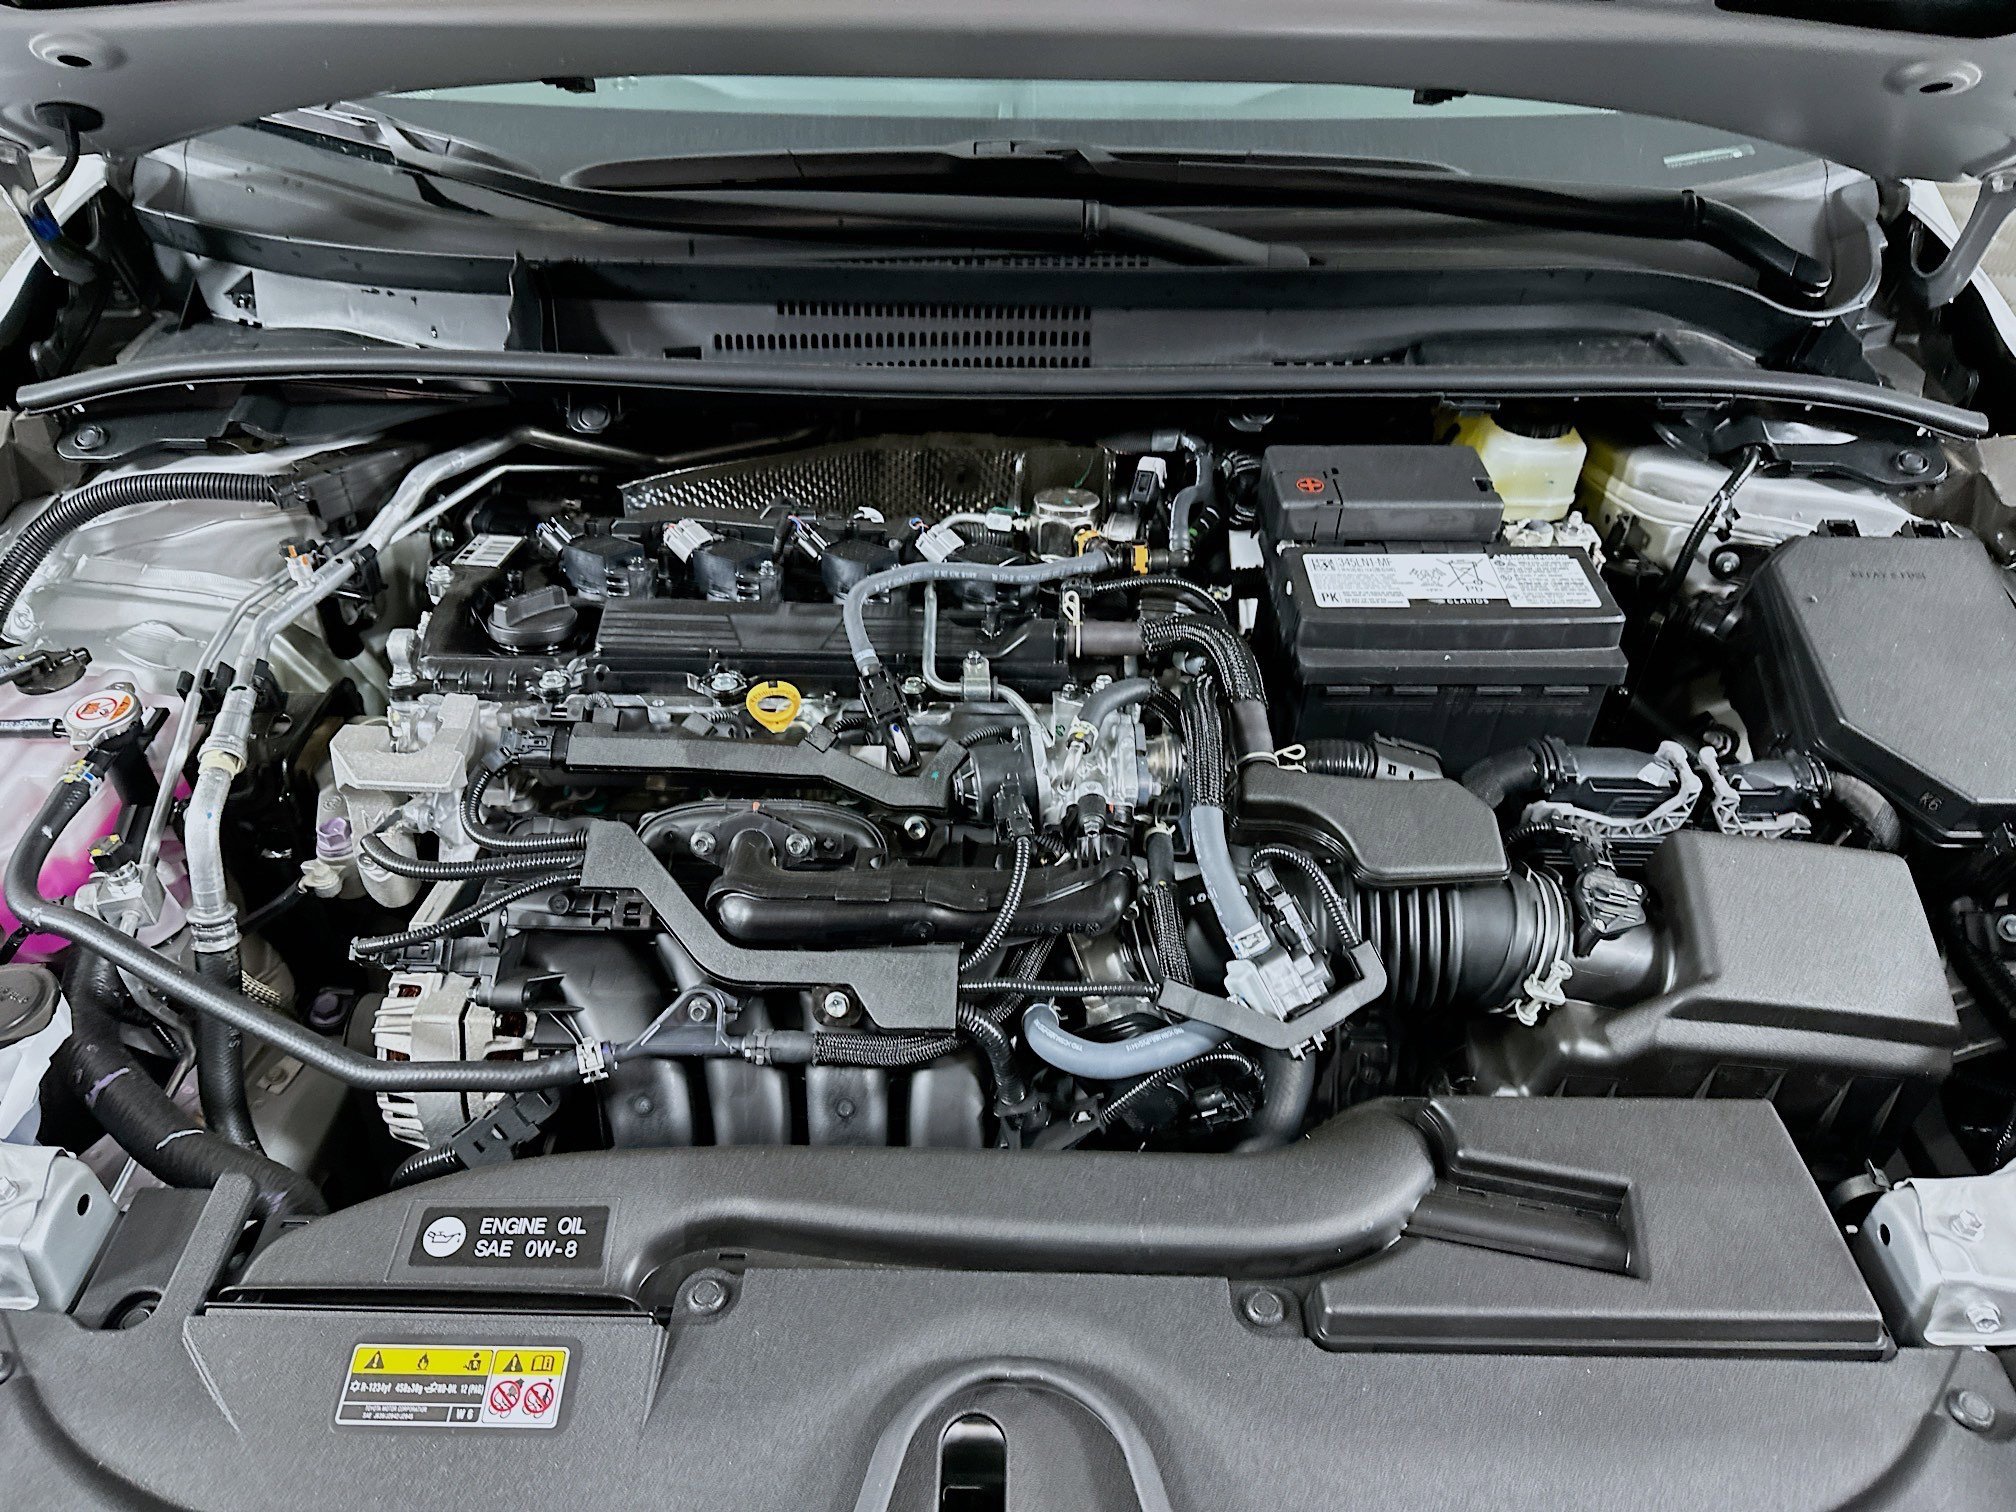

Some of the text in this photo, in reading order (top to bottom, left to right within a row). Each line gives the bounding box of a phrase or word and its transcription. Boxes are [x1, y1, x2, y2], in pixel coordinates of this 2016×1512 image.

[1321, 592, 1340, 603] PK
[480, 1217, 587, 1235] ENGINE OIL
[474, 1240, 578, 1258] SAE 0W-8
[456, 1408, 466, 1420] W
